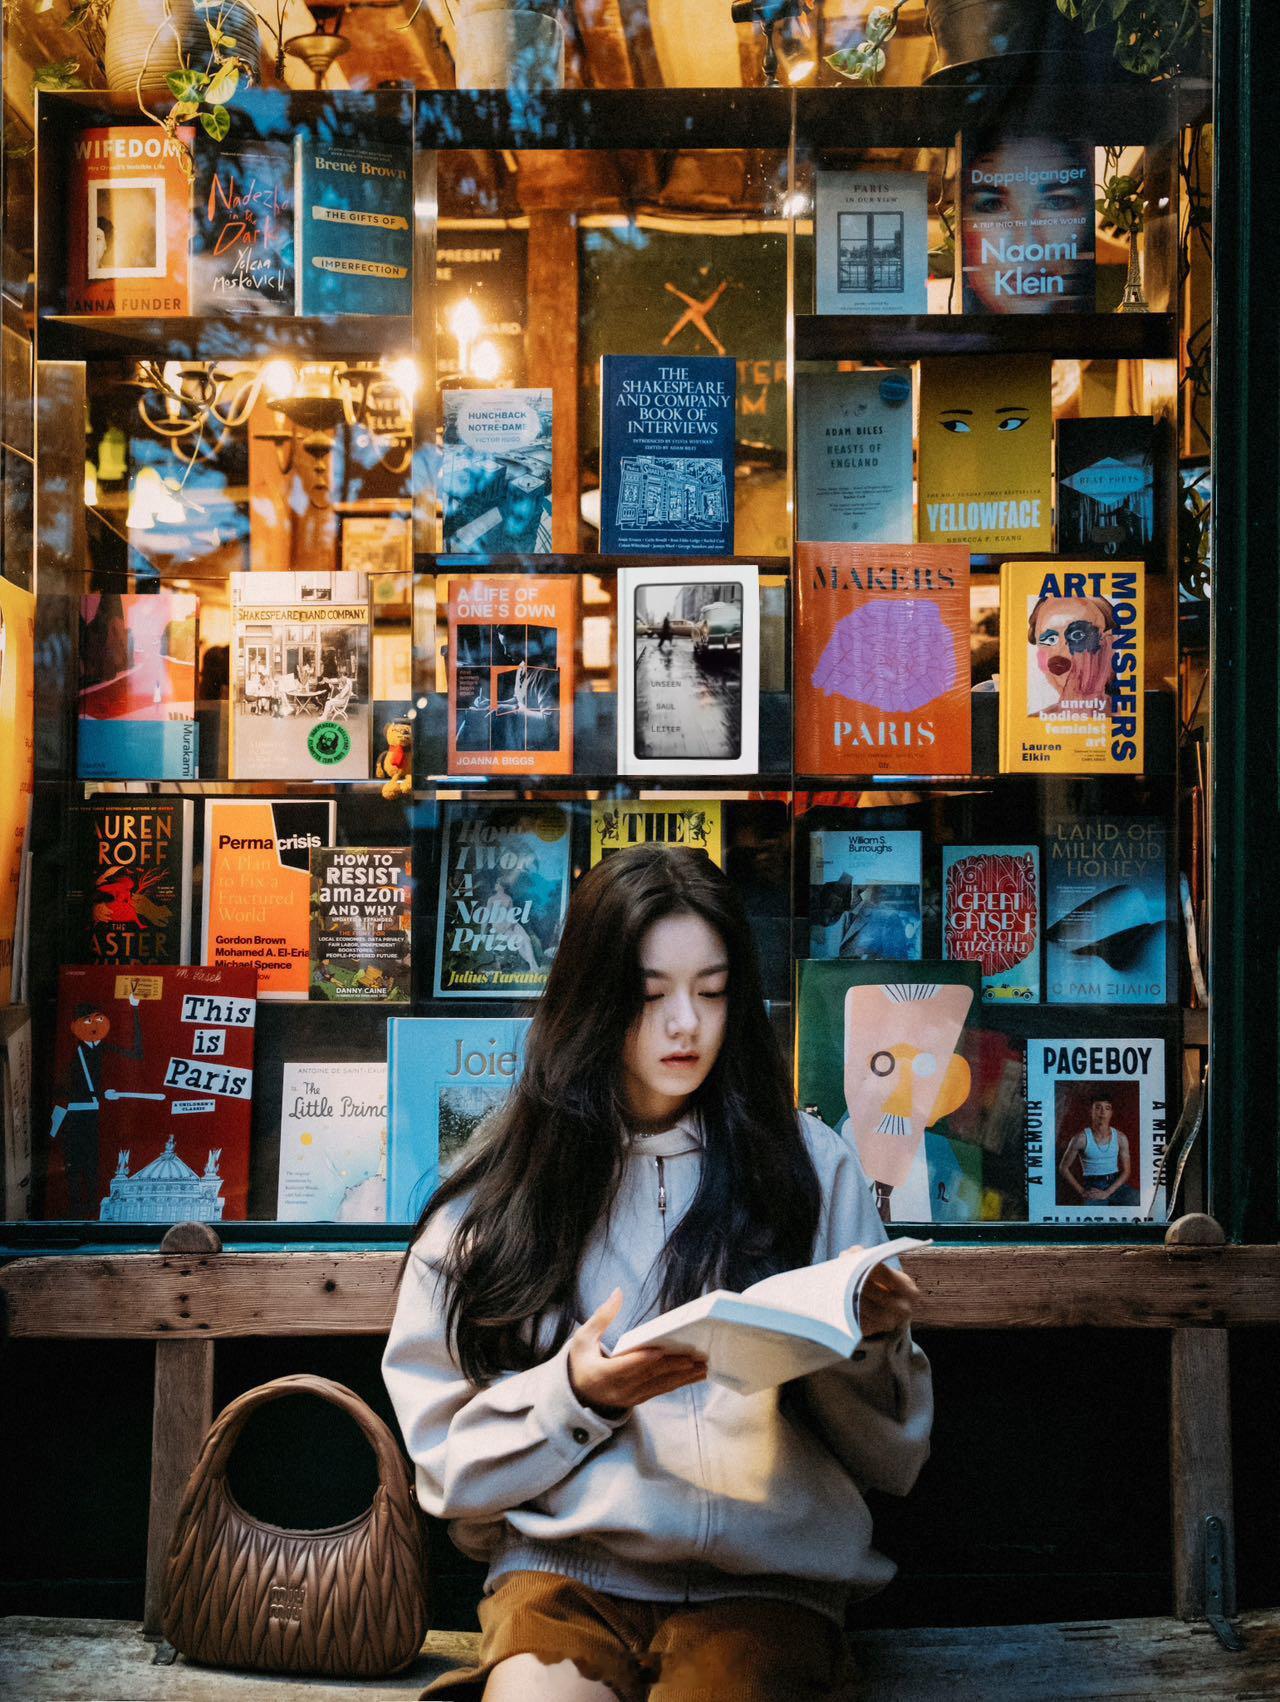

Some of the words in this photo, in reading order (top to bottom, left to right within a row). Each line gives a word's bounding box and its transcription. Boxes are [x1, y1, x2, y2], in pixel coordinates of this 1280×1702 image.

[315, 157, 357, 173] Brené
[361, 162, 407, 179] Brown
[971, 167, 1086, 187] Doppelganger
[854, 184, 890, 193] PARIS
[326, 211, 346, 220] THE
[350, 213, 379, 224] GIFTS
[382, 217, 396, 225] OF
[1060, 217, 1087, 225] WORLD
[981, 233, 1078, 264] Naomi
[321, 259, 400, 275] IMPERFECTION
[994, 266, 1064, 296] Klein
[74, 299, 116, 312] ANNA
[122, 298, 181, 311] FUNDER
[658, 367, 689, 381] THE
[622, 380, 725, 395] SHAKESPEARE
[616, 394, 651, 408] AND
[654, 394, 731, 408] COMPANY
[468, 411, 527, 420] HUNCHBACK
[639, 407, 682, 421] BOOK
[687, 407, 707, 421] OF
[627, 421, 718, 435] INTERVIEWS
[825, 428, 851, 437] ADAM
[856, 426, 883, 436] BILES
[869, 444, 882, 453] OF
[831, 458, 879, 468] ENGLAND
[926, 499, 1041, 532] YELLOWFACE
[813, 566, 955, 591] MAKERS
[1039, 573, 1106, 598] ART
[457, 588, 469, 601] A
[473, 588, 511, 601] LIFE
[515, 588, 539, 602] OF
[239, 608, 300, 620] SHAKESPEARE
[307, 610, 326, 619] AND
[328, 609, 367, 619] COMPANY
[457, 604, 510, 618] ONE'S
[514, 604, 556, 618] OWN
[1111, 572, 1137, 762] MONSTERS
[1061, 698, 1107, 710] unruly
[1040, 711, 1088, 721] bodies
[1093, 711, 1107, 721] in
[651, 725, 681, 733] LEITER
[833, 721, 936, 746] PARIS
[1045, 723, 1107, 734] feminist
[1022, 743, 1062, 751] Lauren
[1086, 737, 1107, 748] art
[182, 724, 193, 777] Murakami
[1022, 753, 1051, 762] Elkin
[456, 756, 499, 766] JOANNA
[502, 756, 535, 766] BIGGS
[96, 815, 173, 839] UREN
[622, 812, 685, 843] THE
[1058, 824, 1119, 840] LAND
[1128, 824, 1158, 840] OF
[849, 836, 879, 845] William
[880, 836, 886, 844] S.
[99, 841, 168, 865] ROFF
[849, 844, 893, 855] Burroughs
[1052, 842, 1105, 858] MILK
[1112, 842, 1161, 858] AND
[333, 855, 370, 866] HOW
[373, 855, 393, 866] TO
[455, 847, 472, 870] I
[475, 847, 537, 870] Won
[1067, 860, 1147, 877] HONEY
[326, 867, 401, 886] RESIST
[452, 873, 474, 897] A
[320, 887, 405, 903] amazon
[957, 892, 1022, 912] GREAT
[219, 908, 265, 922] World
[329, 905, 360, 915] AND
[364, 905, 397, 916] WHY
[454, 900, 533, 924] Nobel
[112, 923, 127, 931] THE
[951, 912, 1032, 934] GATSBY
[91, 932, 168, 956] STER
[215, 935, 252, 945] Gordon
[254, 935, 287, 945] Brown
[450, 928, 523, 952] Prize
[957, 941, 1029, 953] FITZGERALD
[215, 947, 265, 957] Mohamed
[266, 947, 277, 957] A.
[277, 947, 310, 958] El-Eria
[215, 960, 253, 968] Michael
[254, 960, 292, 970] Spence
[447, 970, 489, 987] Julius
[1053, 984, 1063, 995] C
[1070, 984, 1100, 995] PAM
[1104, 984, 1161, 995] ZHANG
[185, 996, 251, 1023] This
[194, 1031, 220, 1053] is
[447, 1038, 517, 1077] Joie
[1043, 1047, 1152, 1075] PAGEBOY
[166, 1059, 247, 1095] Paris
[304, 1082, 320, 1095] The
[289, 1097, 333, 1119] Little
[340, 1096, 387, 1118] Princ
[1152, 1100, 1166, 1110] A
[1028, 1175, 1042, 1185] A
